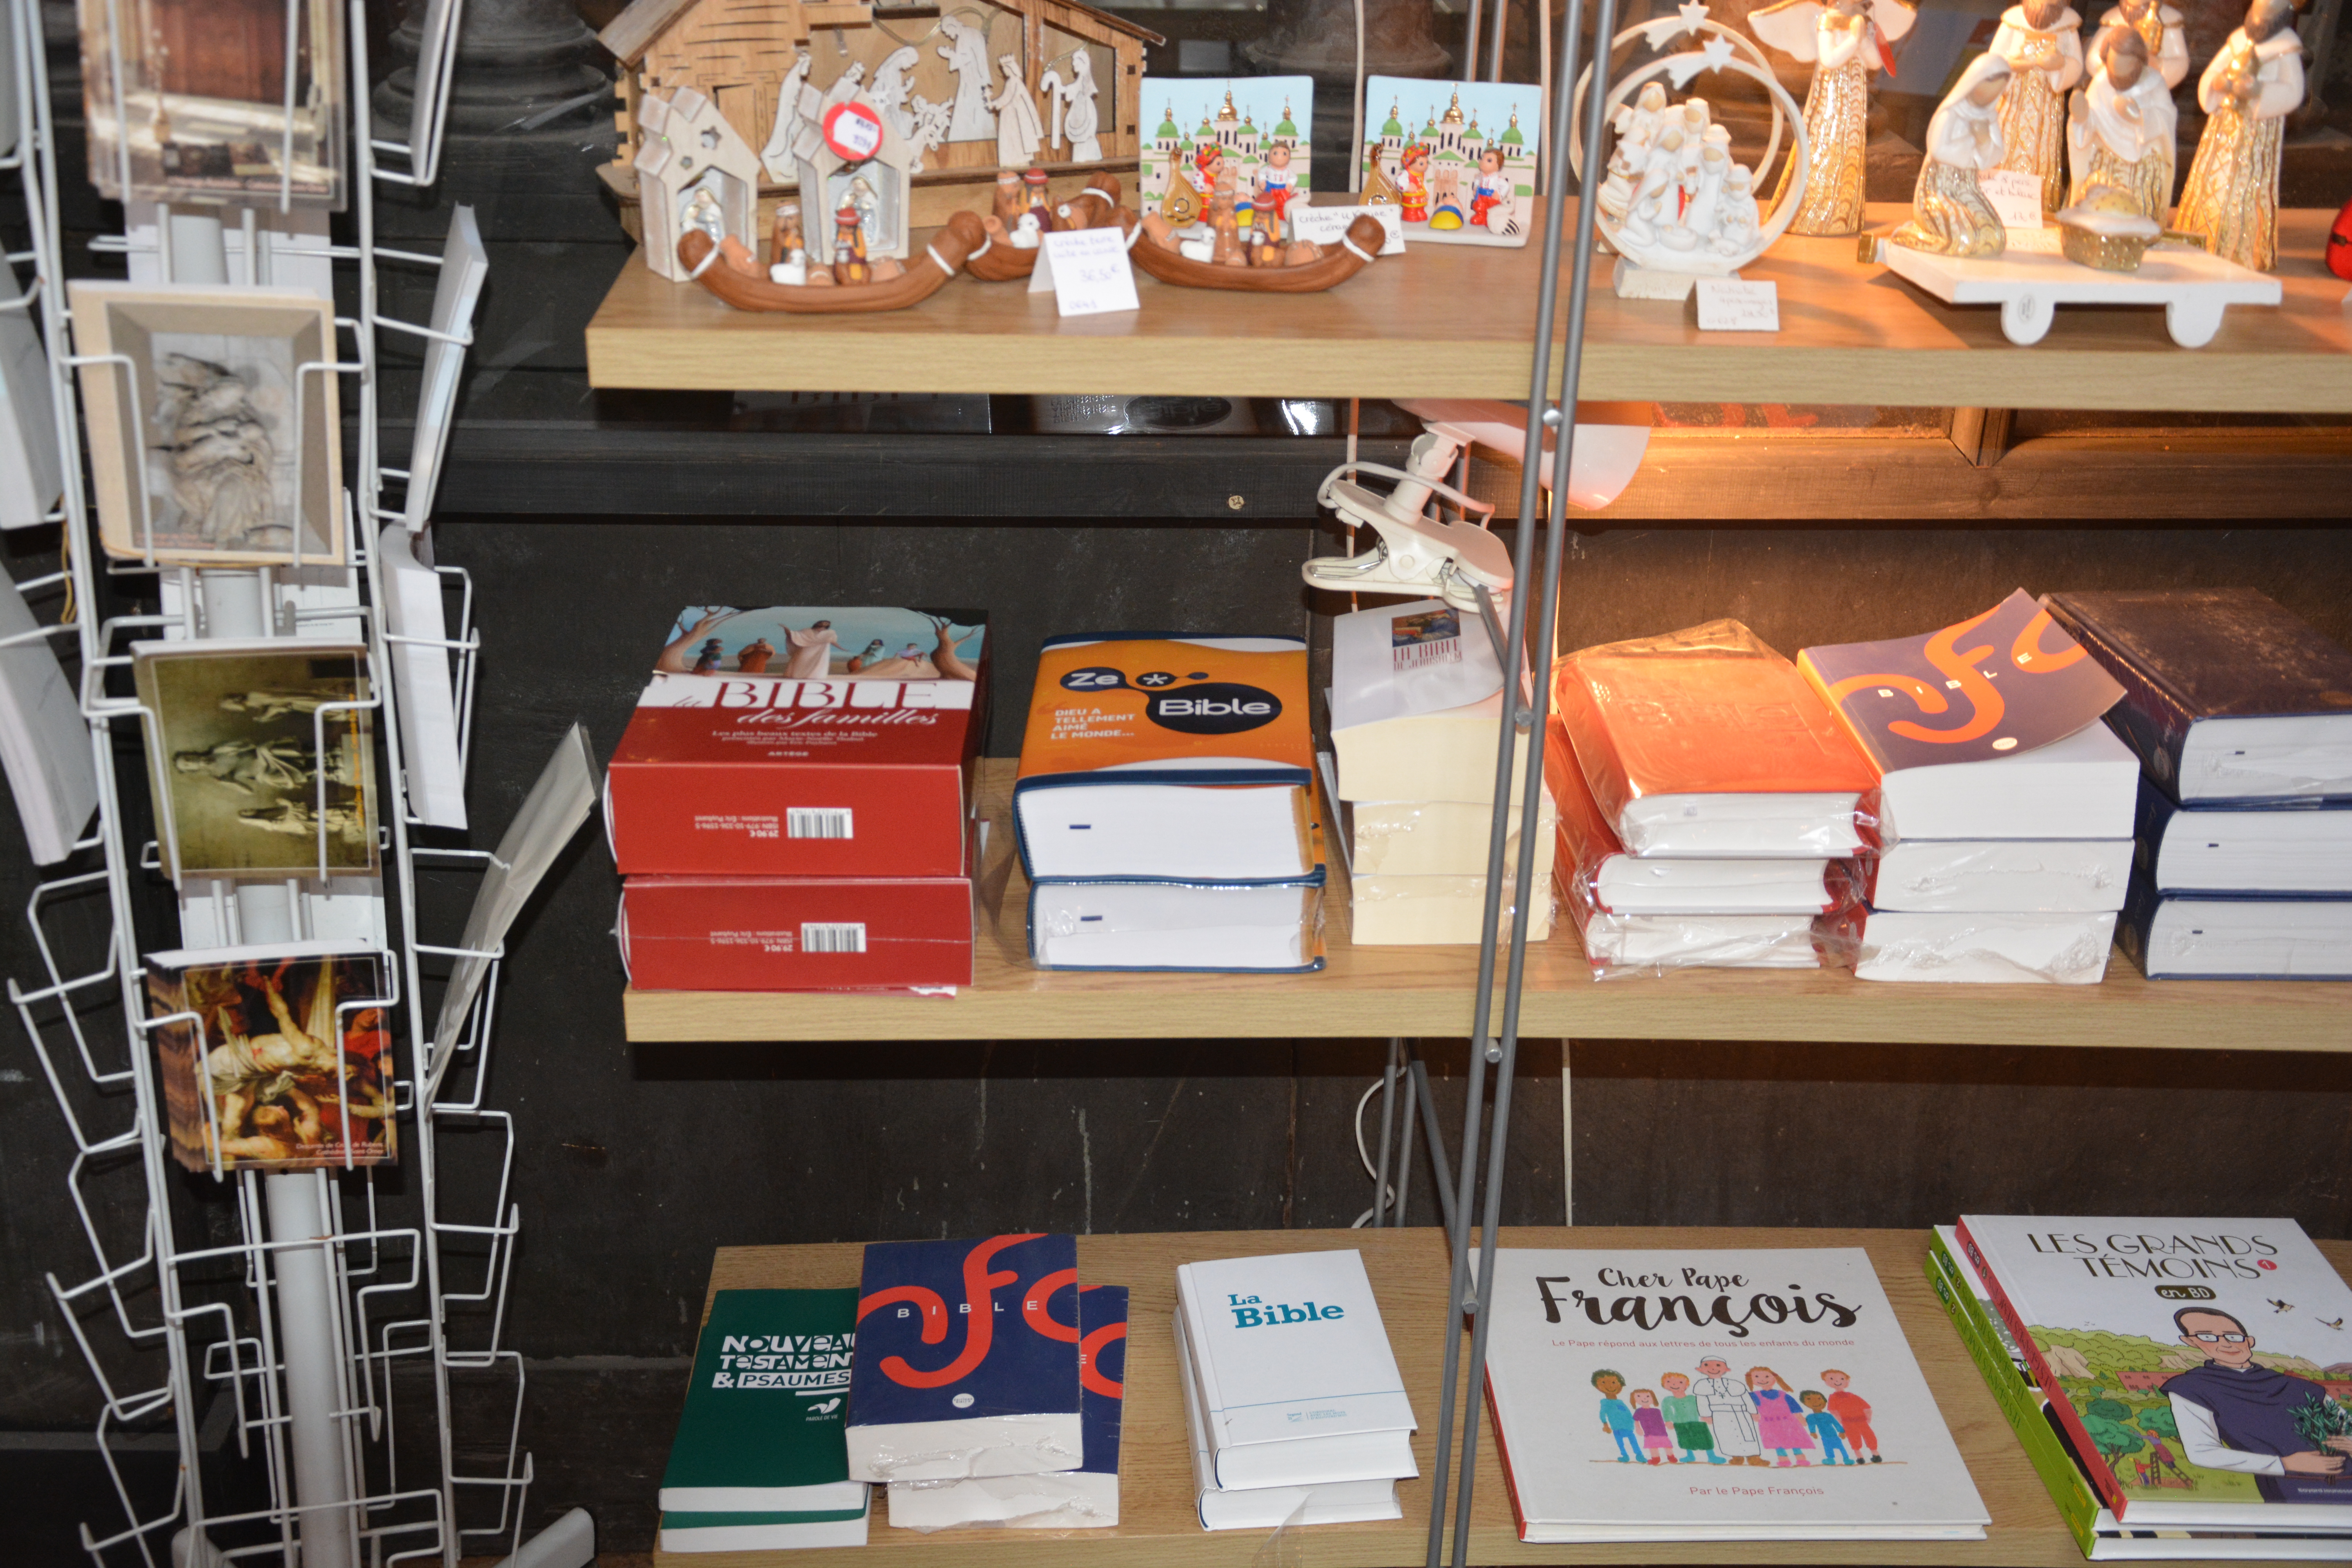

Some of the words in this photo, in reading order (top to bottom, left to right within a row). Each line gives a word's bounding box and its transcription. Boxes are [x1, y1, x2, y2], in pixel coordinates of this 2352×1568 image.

[1068, 672, 1119, 687] Ze
[712, 682, 937, 708] BIBLE
[1055, 708, 1087, 717] DIEU
[1159, 698, 1271, 716] Bible
[737, 708, 795, 724] des
[776, 708, 939, 730] familles
[1055, 713, 1136, 724] TELLEMENT
[1052, 722, 1088, 732] AIMÉ
[1051, 731, 1069, 740] LE
[2027, 1233, 2098, 1254] LES
[2106, 1234, 2278, 1255] GRANDS
[2073, 1254, 2261, 1279] TÉMOINS
[1598, 1267, 1673, 1288] Cher
[1681, 1267, 1749, 1292] Pape
[1228, 1294, 1262, 1306] La
[2161, 1289, 2186, 1298] en
[2189, 1288, 2210, 1298] BD
[897, 1301, 1038, 1318] BIBLE
[1536, 1275, 1862, 1338] François
[1231, 1301, 1345, 1329] Bible
[1568, 1339, 1595, 1348] Pape
[1599, 1339, 1635, 1348] répond
[712, 1372, 735, 1388] &
[742, 1372, 851, 1387] PSAUMES
[1690, 1486, 1714, 1496] Par
[1717, 1486, 1728, 1496] le
[1732, 1486, 1765, 1497] Pape
[1768, 1486, 1825, 1497] François
